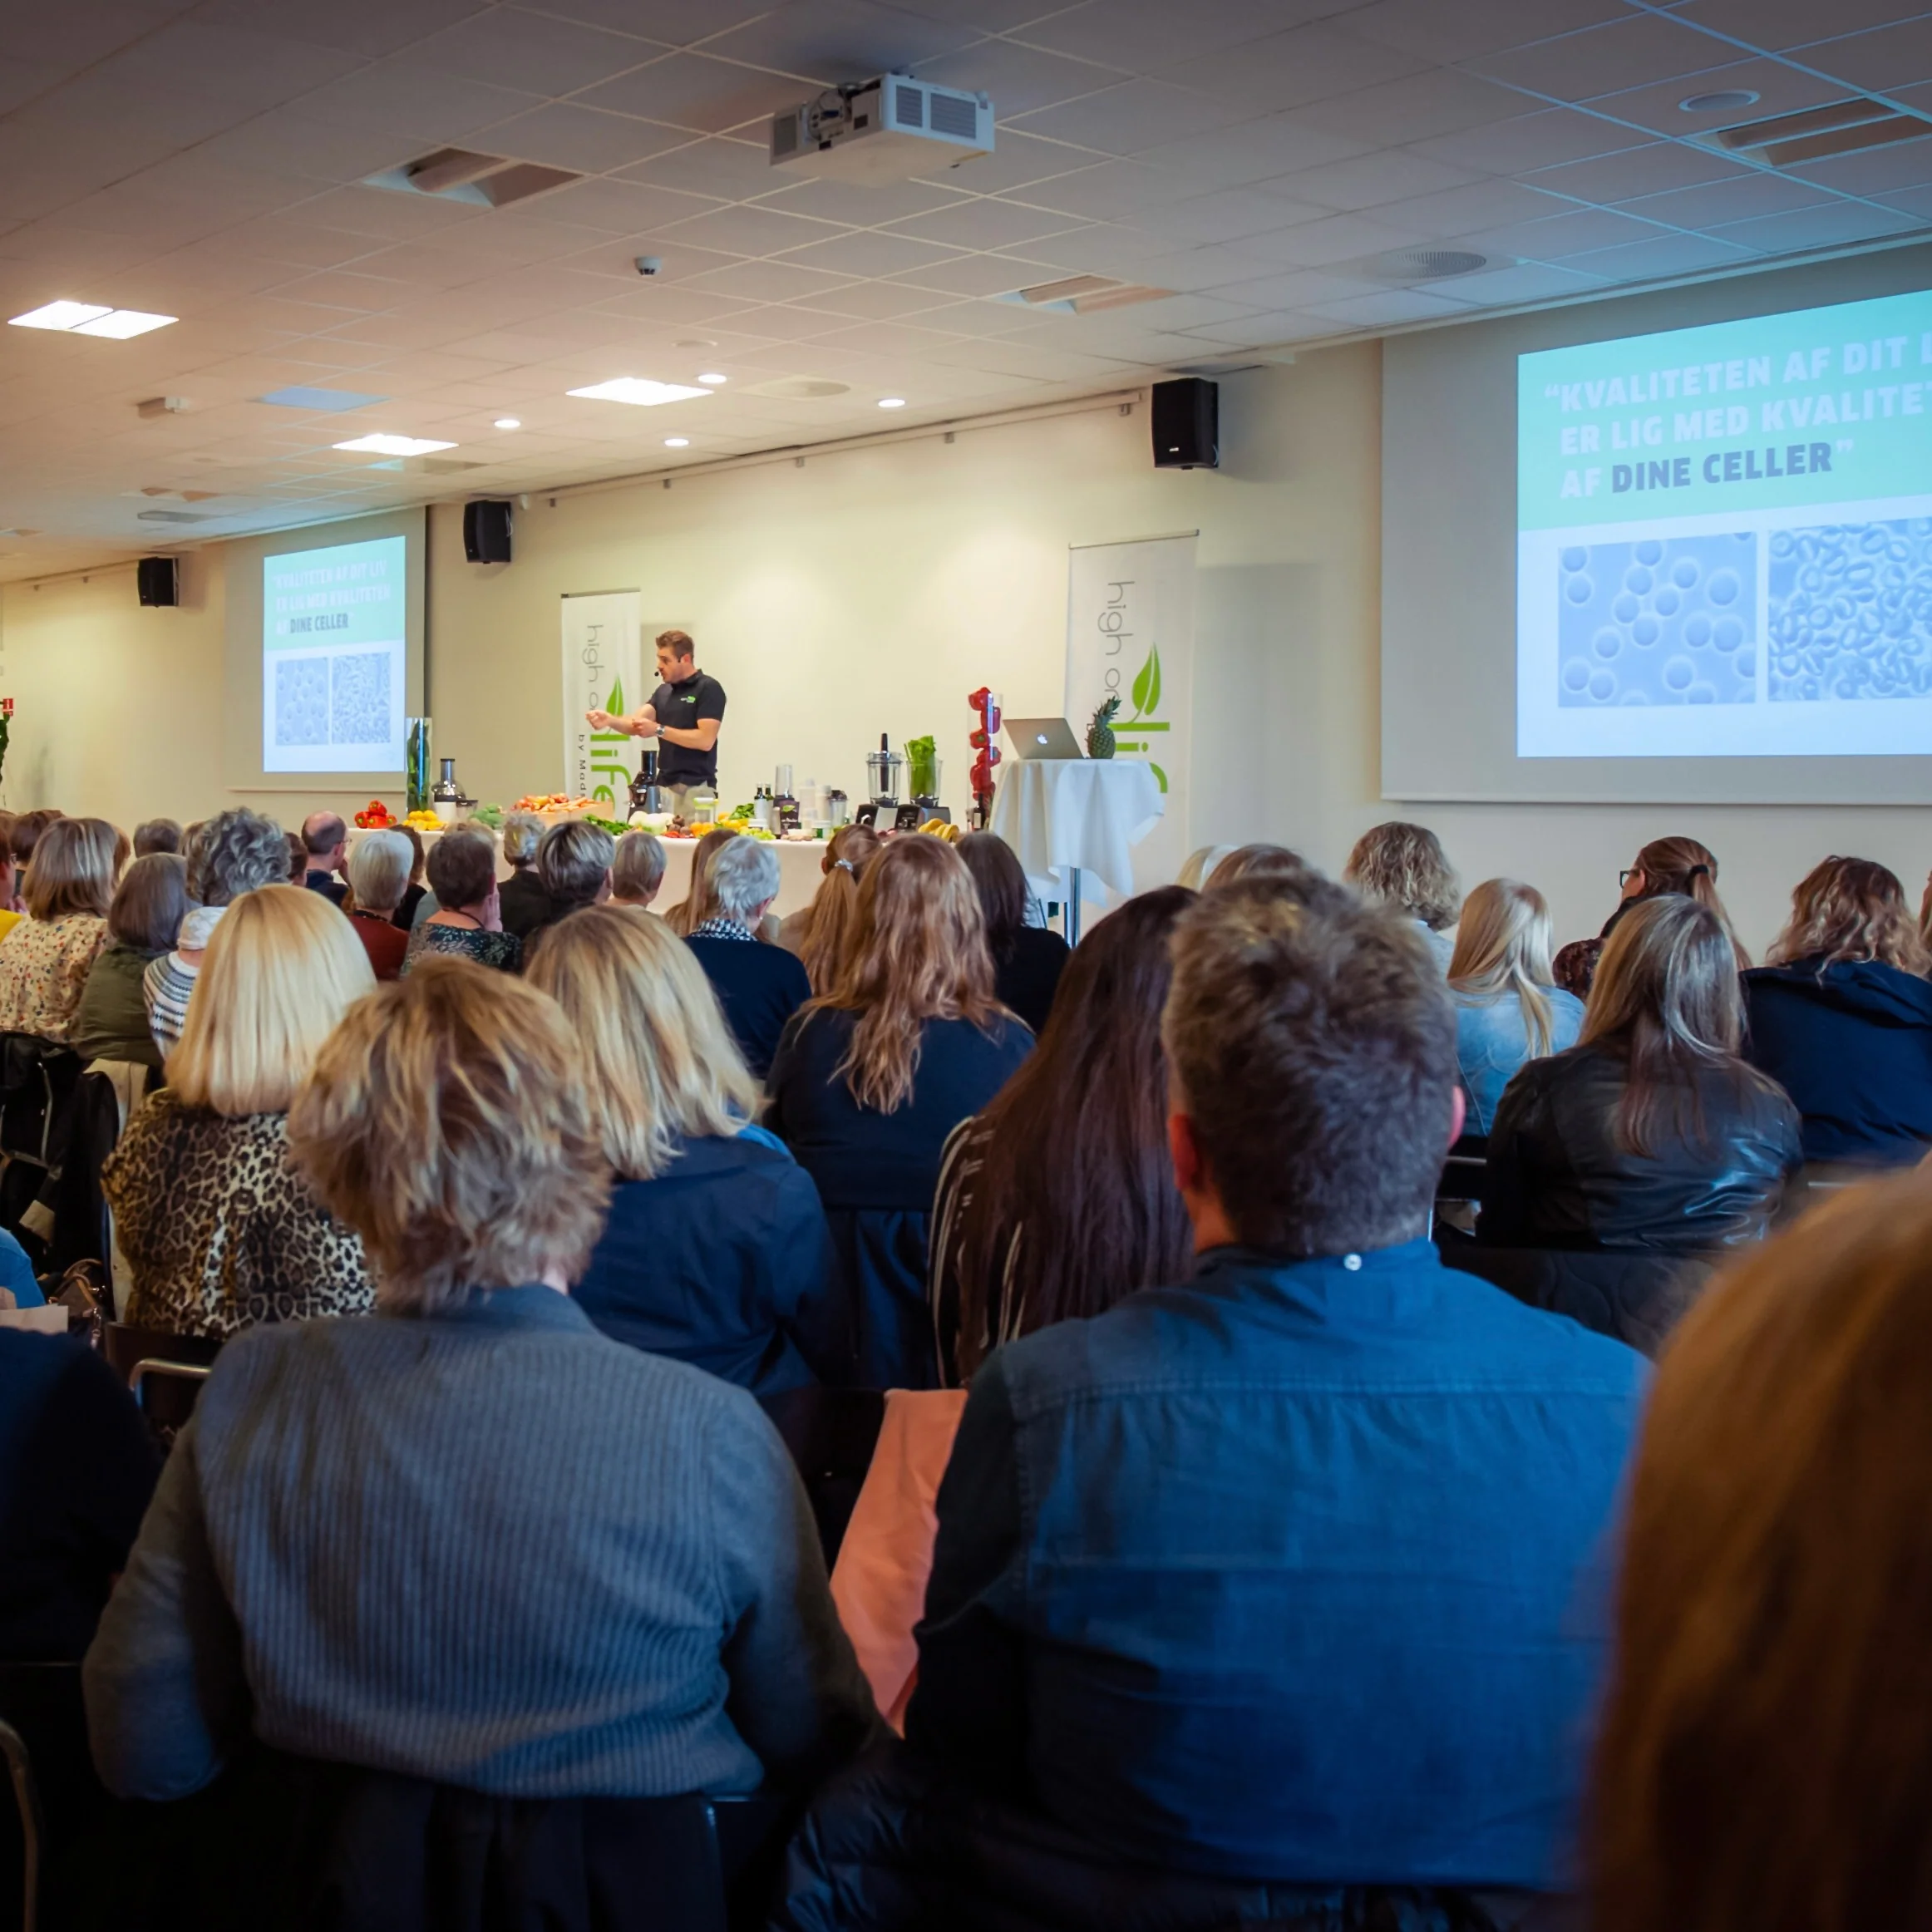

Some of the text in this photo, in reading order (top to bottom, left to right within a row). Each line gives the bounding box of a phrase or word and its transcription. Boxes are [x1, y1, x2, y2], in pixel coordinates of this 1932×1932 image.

[1545, 357, 1770, 412] “KVALITETEN
[1783, 347, 1832, 384] AF
[1843, 336, 1908, 375] DIT
[1560, 425, 1600, 456] ER
[1611, 416, 1663, 450] LIG
[1673, 406, 1750, 443] MED
[1560, 439, 1854, 499] AF DINE CELLER”
[289, 617, 313, 633] DINE
[1097, 581, 1135, 655] high
[582, 624, 604, 711] high o
[578, 734, 585, 751] by
